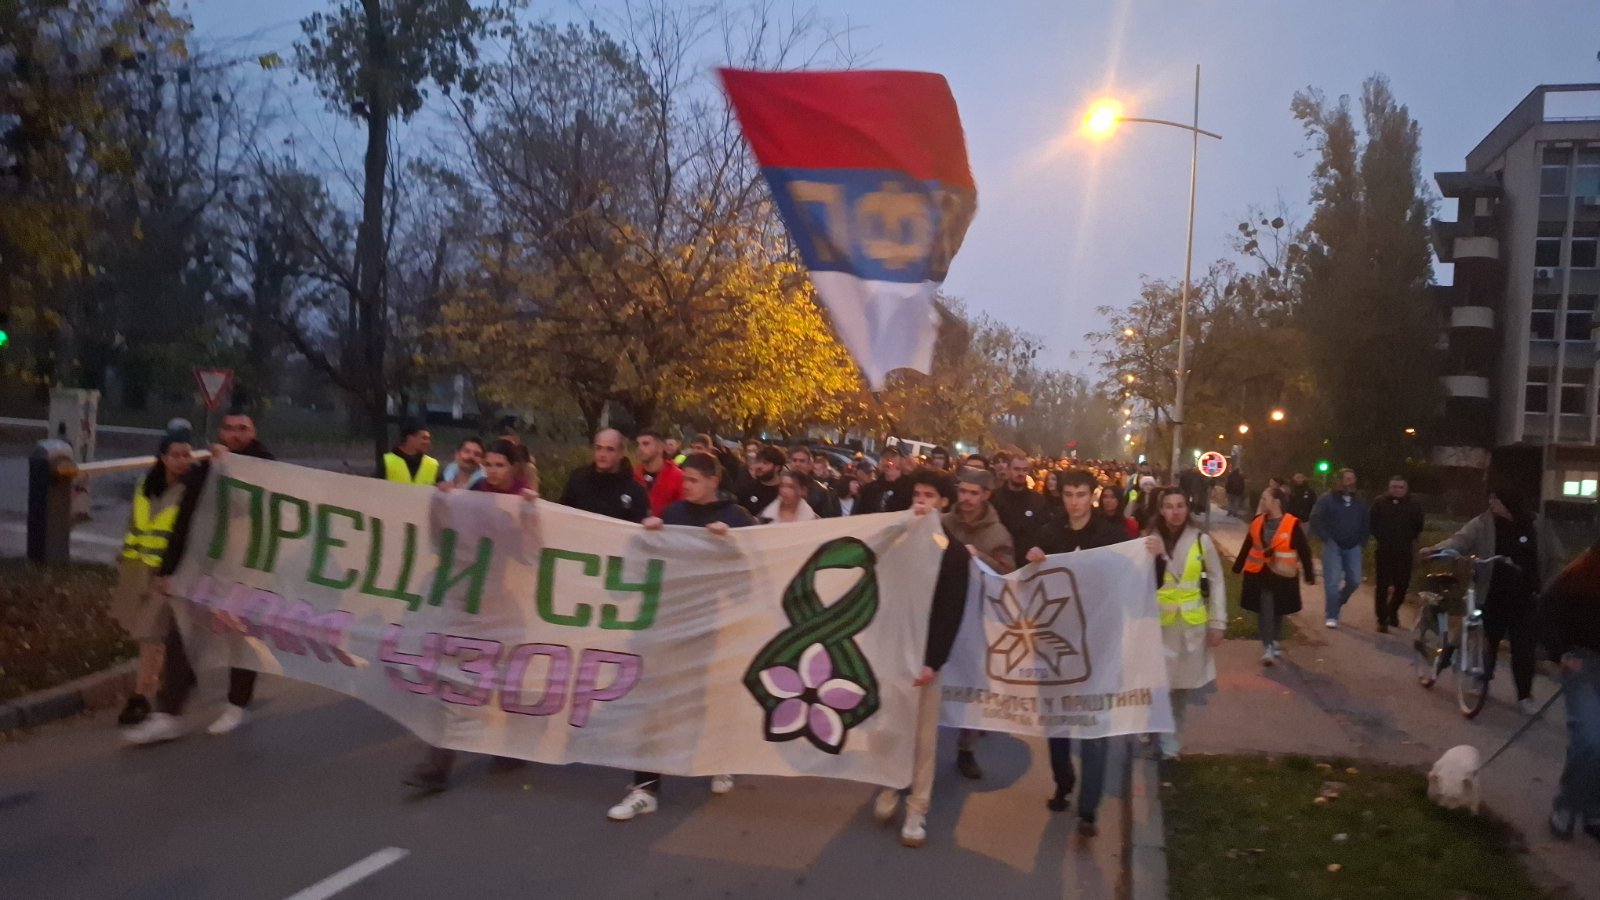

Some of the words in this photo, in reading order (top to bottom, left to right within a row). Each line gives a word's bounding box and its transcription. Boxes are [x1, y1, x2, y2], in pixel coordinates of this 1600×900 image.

[207, 476, 493, 614] ПРЕЦИ
[536, 547, 665, 630] СУ
[379, 623, 643, 728] УЗОР
